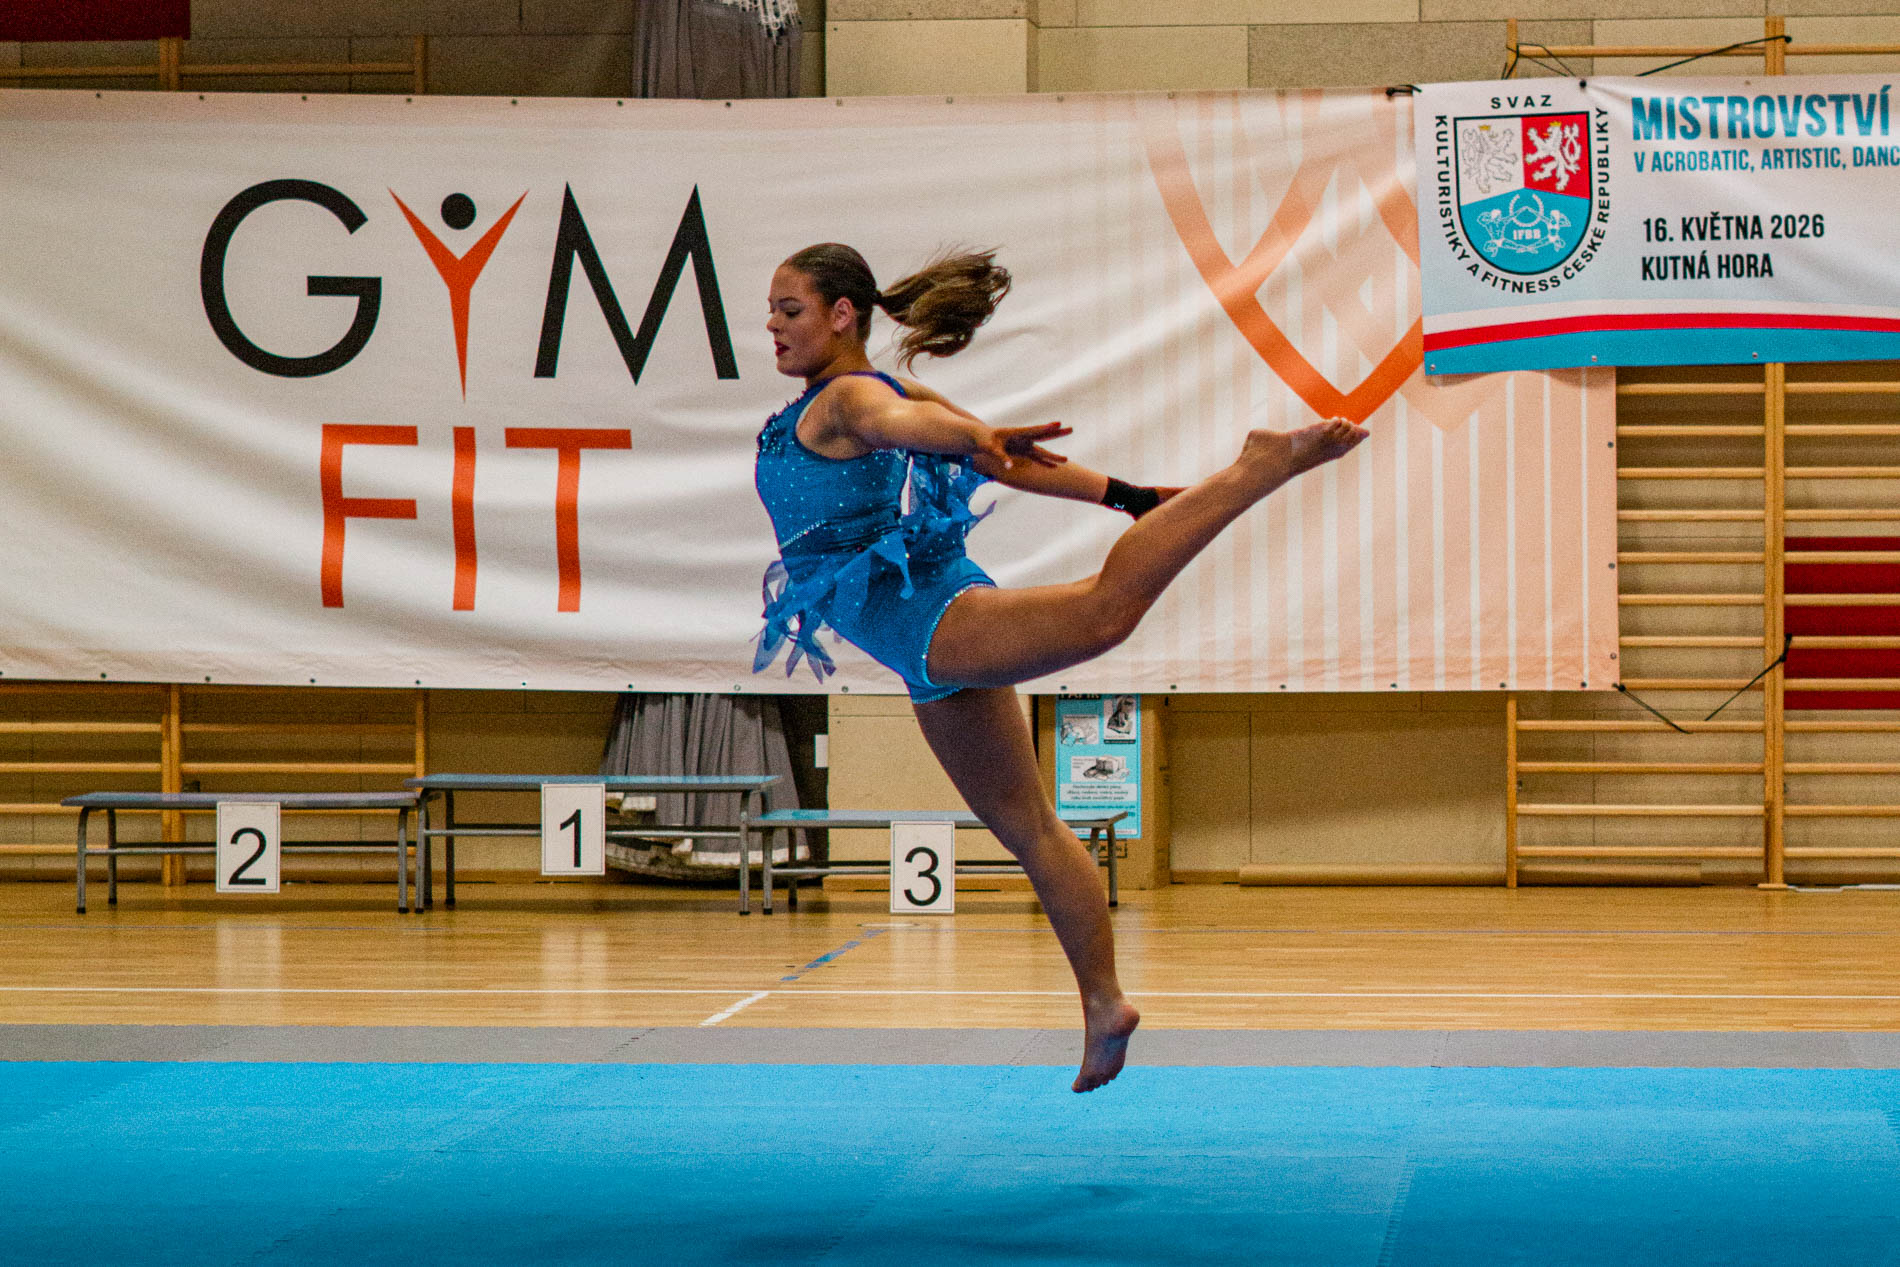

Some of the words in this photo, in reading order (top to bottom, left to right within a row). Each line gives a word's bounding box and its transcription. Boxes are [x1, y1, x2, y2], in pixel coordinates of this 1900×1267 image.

[1490, 95, 1552, 109] SVAZ
[1632, 84, 1892, 140] MISTROVSTVÍ
[1634, 151, 1645, 172] V
[1651, 149, 1755, 172] ACROBATIC,
[1761, 147, 1846, 171] ARTISTIC,
[1852, 145, 1900, 167] DANC
[1435, 115, 1470, 261] KULTURISTIKY
[1466, 263, 1480, 276] A
[1481, 271, 1561, 293] FITNESS
[1563, 227, 1606, 279] ČESKÉ
[1595, 107, 1610, 223] REPUBLIKY
[1643, 217, 1674, 242] 16.
[1681, 211, 1763, 241] KVĚTNA
[1770, 214, 1824, 239] 2026
[1513, 229, 1541, 240] IFBB
[200, 178, 740, 404] GYM
[1641, 250, 1710, 280] KUTNÁ
[1717, 253, 1774, 279] HORA
[319, 423, 632, 613] FIT
[229, 828, 267, 887] 2
[559, 810, 583, 868] 1
[903, 846, 942, 907] 3
